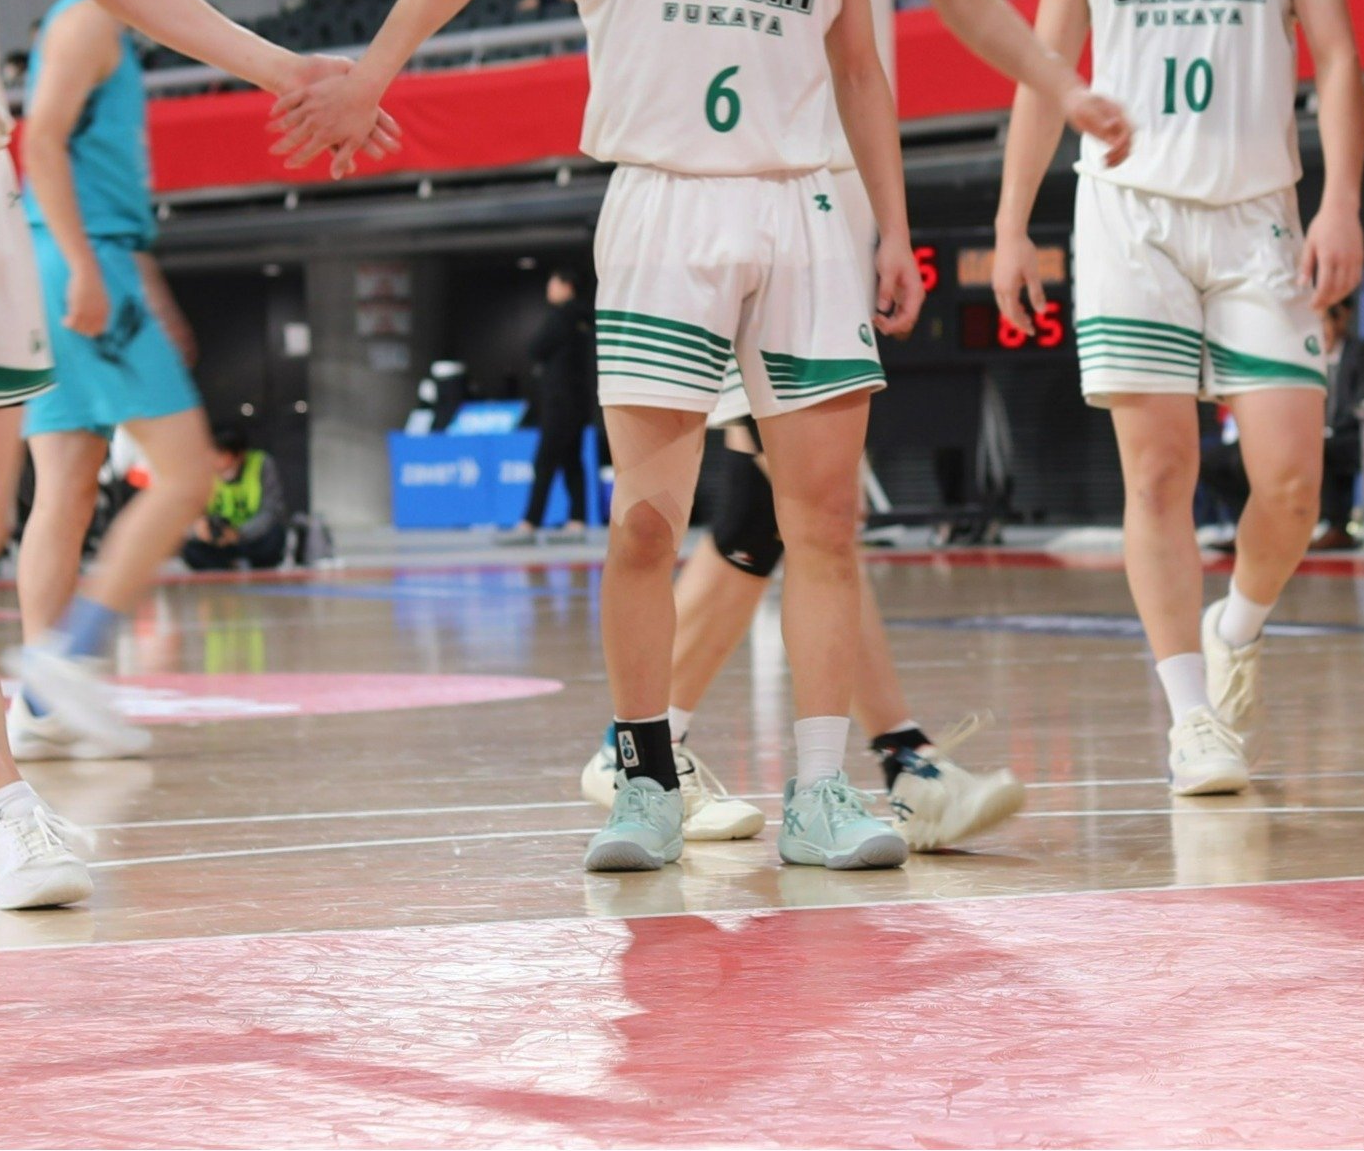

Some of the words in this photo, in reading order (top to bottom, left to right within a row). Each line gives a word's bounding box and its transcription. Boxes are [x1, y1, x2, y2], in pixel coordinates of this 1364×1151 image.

[662, 2, 783, 37] FUKAYA
[1136, 8, 1243, 28] FUKAYA
[705, 65, 741, 133] 6
[1162, 57, 1214, 115] 10
